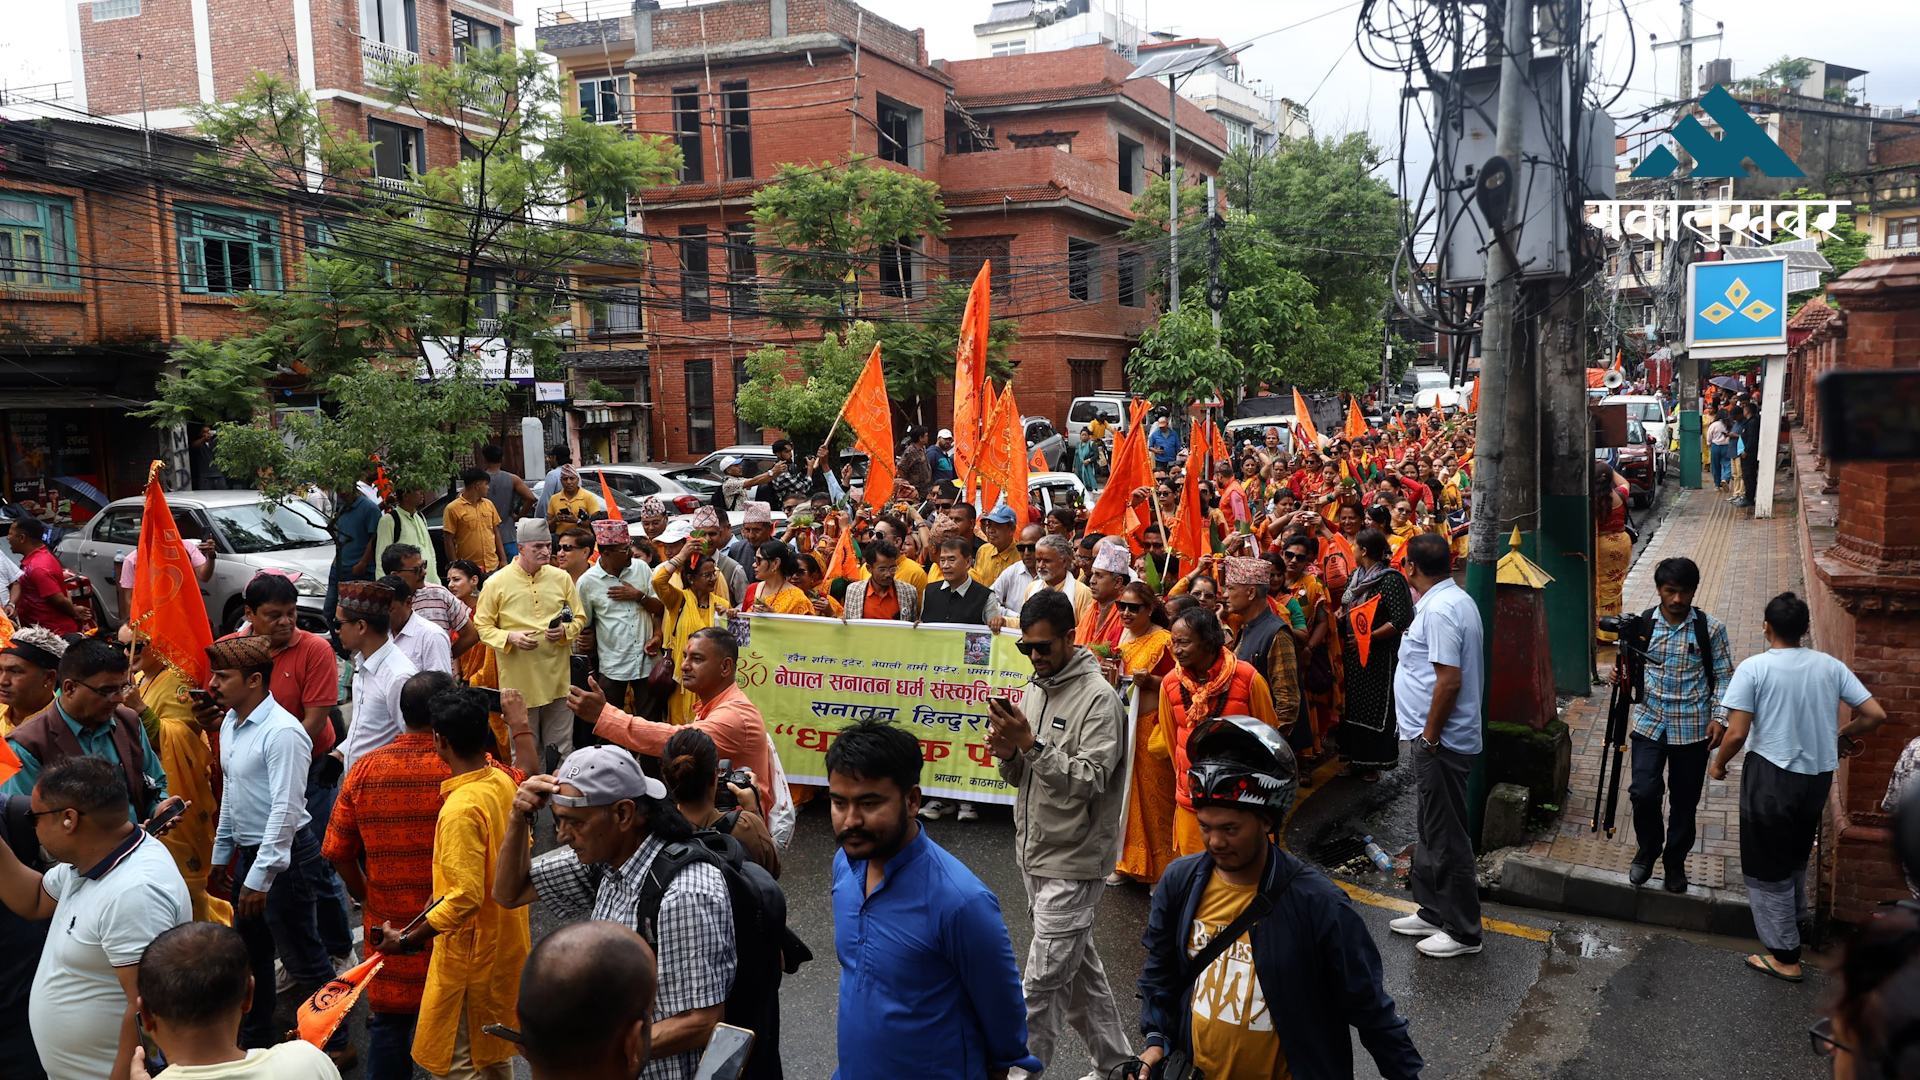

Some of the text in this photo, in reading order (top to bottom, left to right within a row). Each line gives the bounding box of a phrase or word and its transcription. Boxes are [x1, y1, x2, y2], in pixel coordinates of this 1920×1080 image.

[435, 368, 460, 376] BUDDH
[494, 368, 529, 376] FOUDATION
[774, 665, 824, 689] नेपाल
[829, 674, 891, 694] सनातन
[896, 677, 925, 697] धर्म
[930, 680, 992, 706] संस्कृति
[811, 701, 900, 721] सनातन
[566, 765, 580, 779] P
[1193, 919, 1253, 963] BELES
